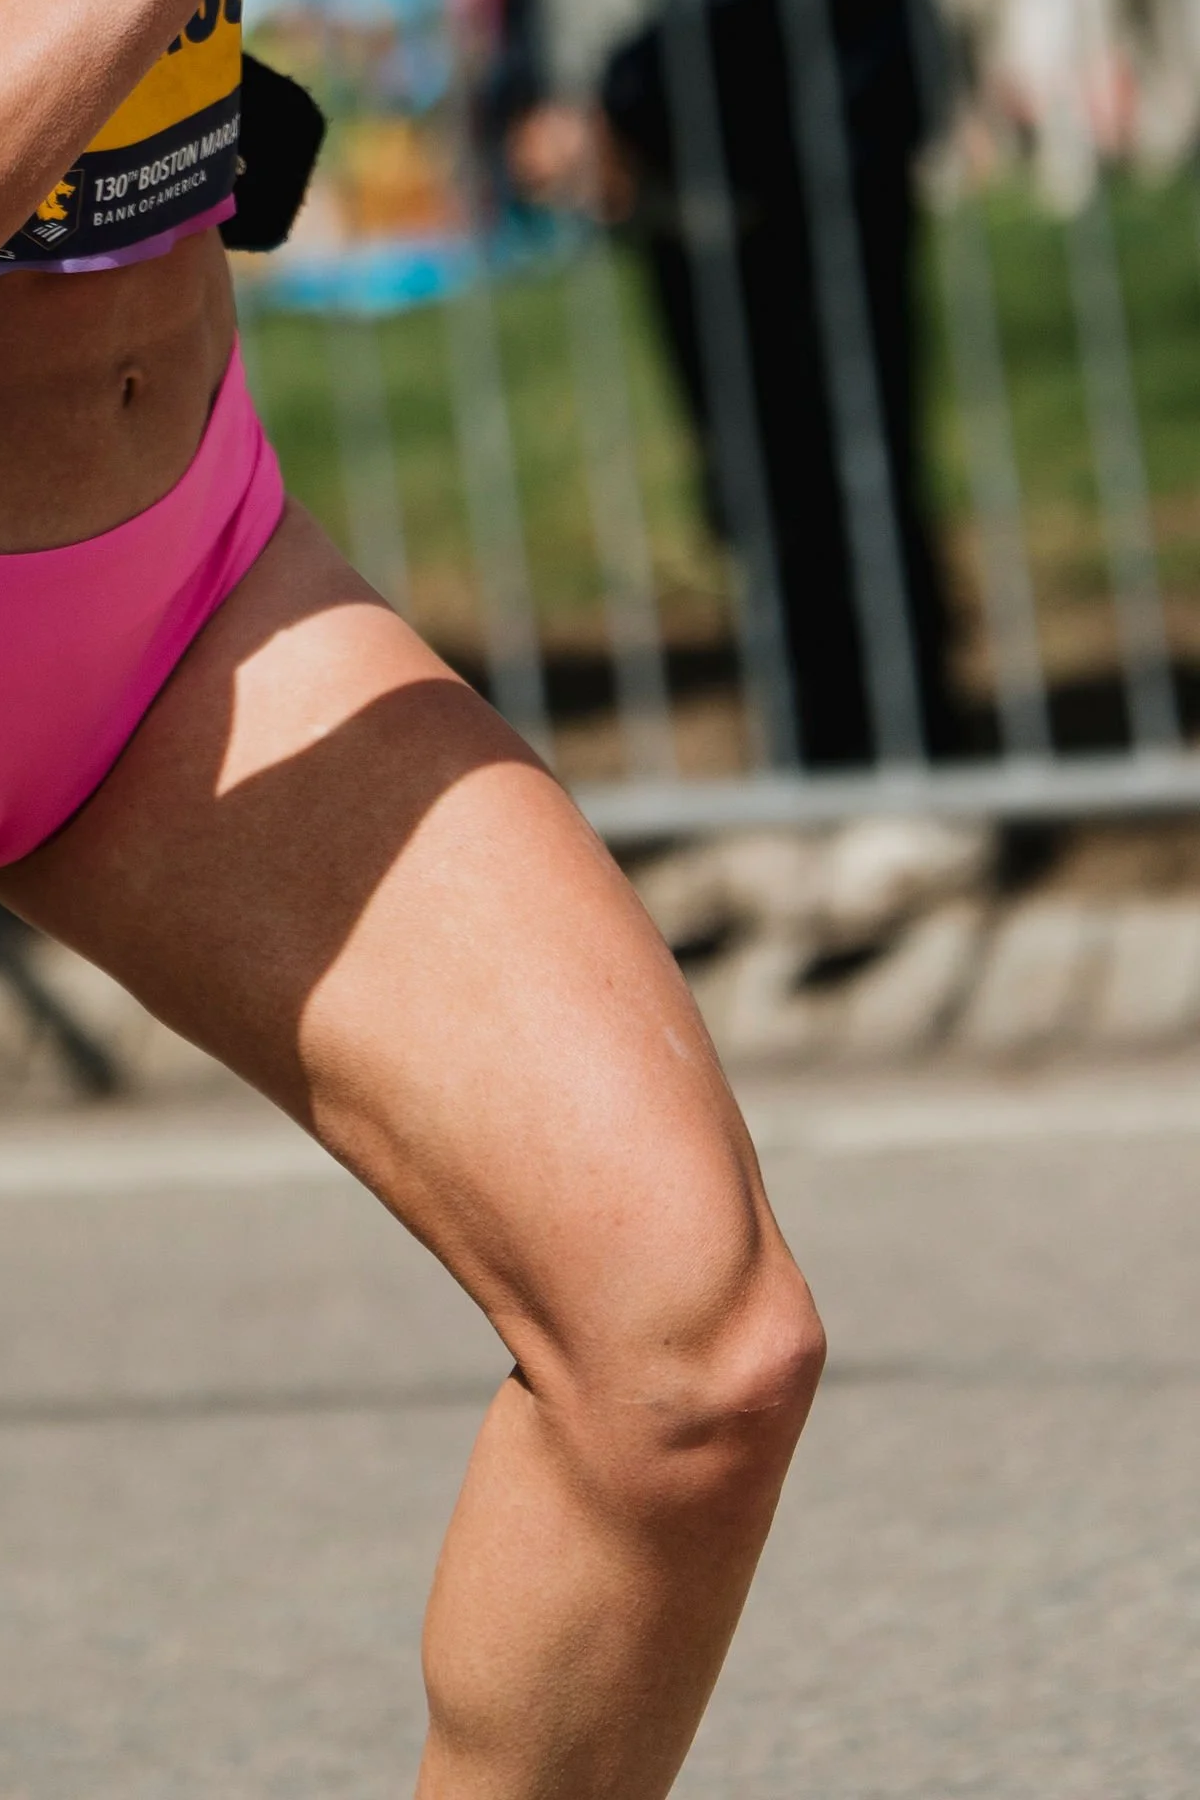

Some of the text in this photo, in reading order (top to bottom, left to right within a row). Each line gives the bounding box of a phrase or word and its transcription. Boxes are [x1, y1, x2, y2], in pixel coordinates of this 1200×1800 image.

[138, 140, 199, 190] BOSTON
[93, 169, 207, 226] BANK OF AMERICA
